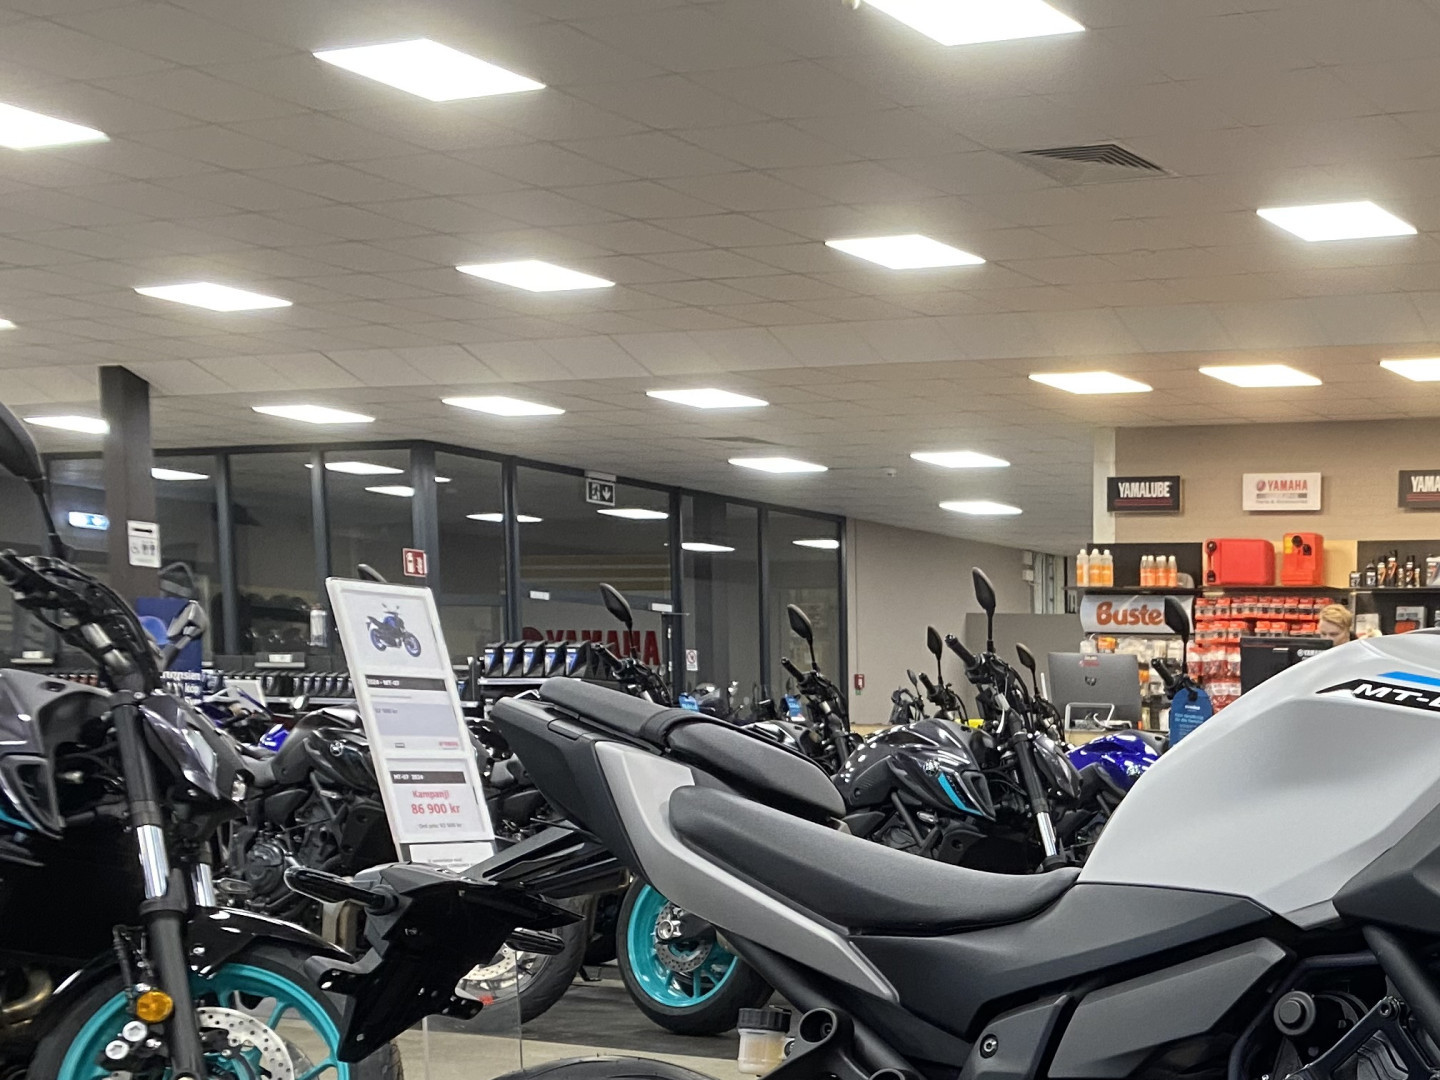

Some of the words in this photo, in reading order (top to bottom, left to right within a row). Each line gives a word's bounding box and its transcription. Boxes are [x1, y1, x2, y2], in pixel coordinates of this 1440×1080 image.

[1118, 481, 1171, 498] YAMALUBE
[1267, 479, 1308, 491] YAMAHA
[1096, 601, 1165, 626] Buste
[411, 803, 425, 814] 86
[427, 803, 448, 814] 900
[449, 803, 460, 813] kr
